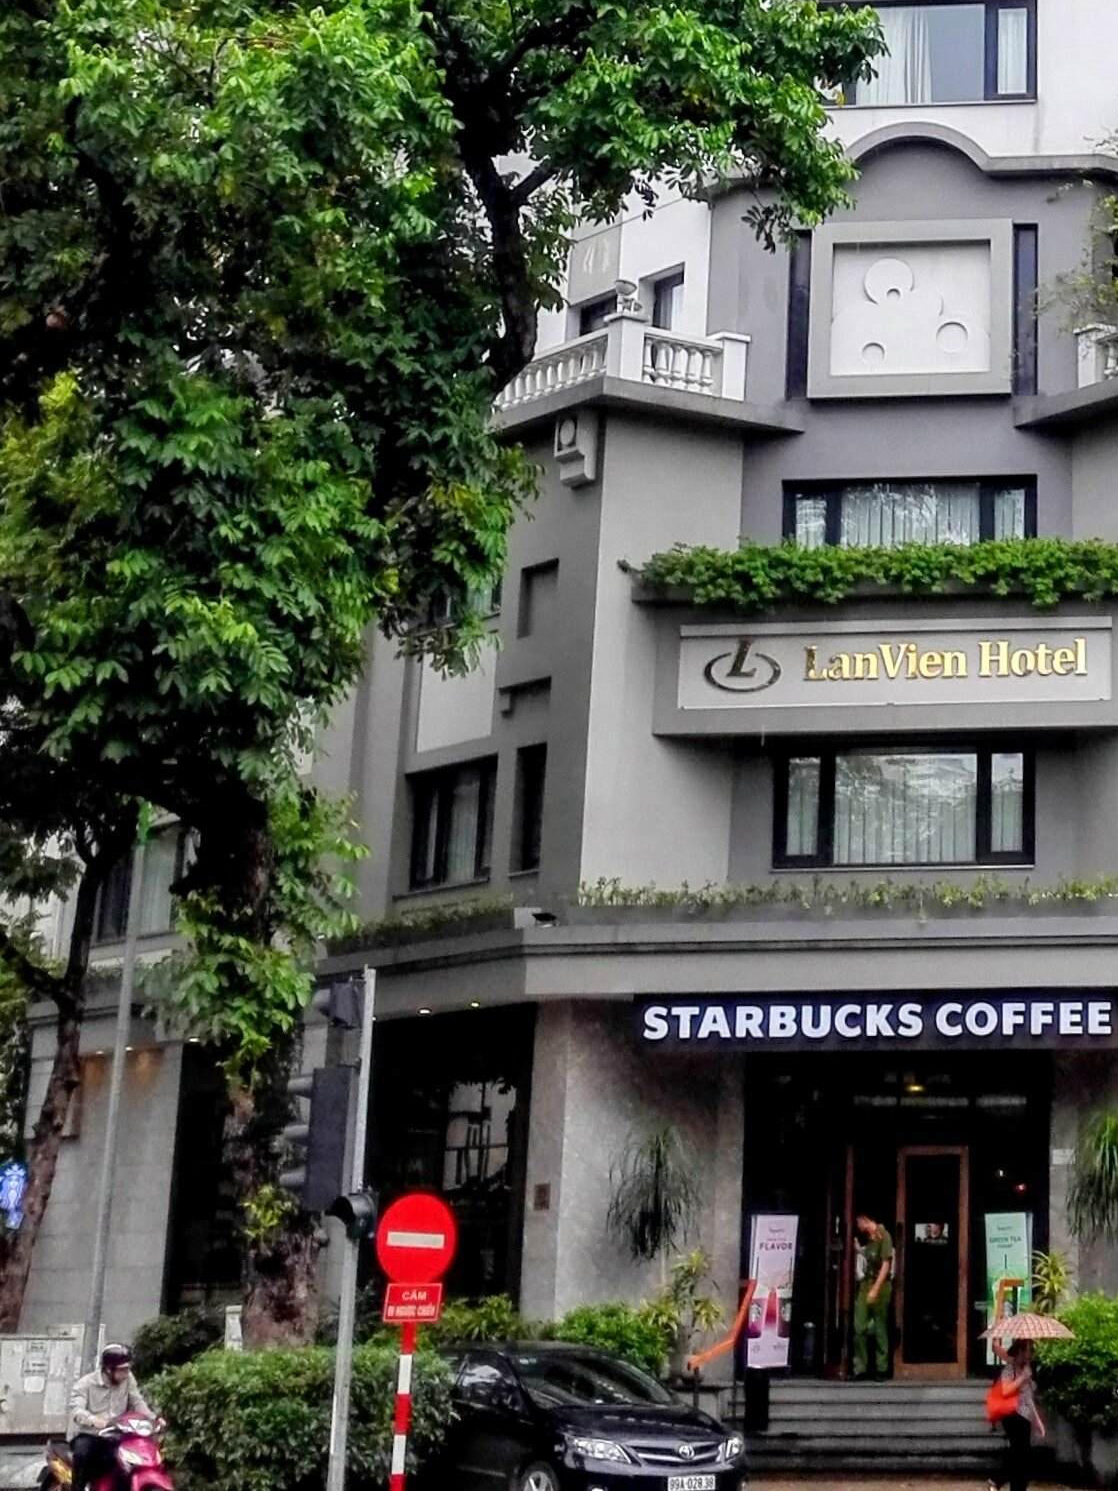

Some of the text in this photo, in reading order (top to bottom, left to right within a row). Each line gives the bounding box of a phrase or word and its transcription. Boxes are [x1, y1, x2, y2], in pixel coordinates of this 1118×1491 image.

[803, 642, 969, 682] LanVien
[977, 637, 1089, 679] Hotel
[642, 1000, 1113, 1040] STARBUCKS COFFEE
[759, 1242, 793, 1251] FLAVOR
